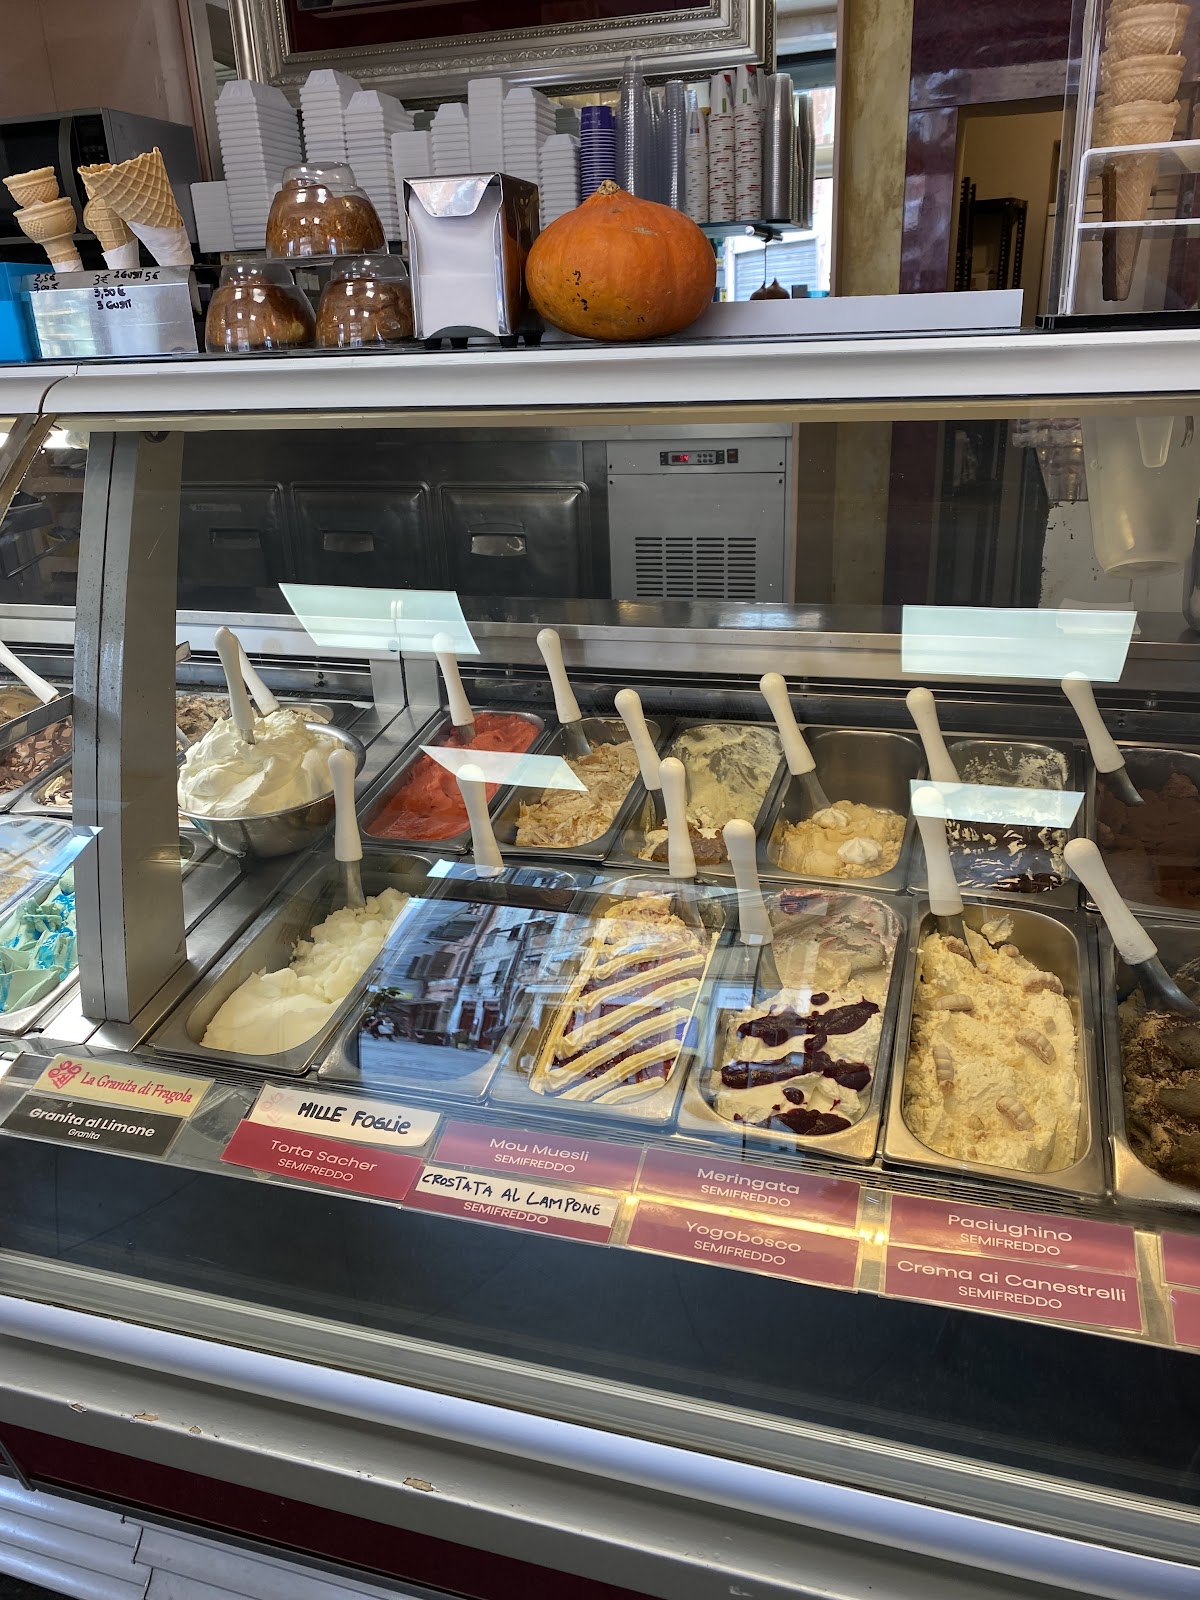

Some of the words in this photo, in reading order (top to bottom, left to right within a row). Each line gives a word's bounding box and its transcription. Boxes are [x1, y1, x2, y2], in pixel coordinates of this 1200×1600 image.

[96, 300, 104, 310] 3
[80, 1072, 95, 1086] La
[97, 1074, 137, 1093] Granita
[138, 1080, 152, 1095] di
[152, 1084, 193, 1105] Fragola
[29, 1107, 82, 1126] Granita
[85, 1116, 100, 1128] al
[99, 1119, 156, 1137] Limone
[297, 1102, 348, 1123] MILLE
[68, 1128, 101, 1140] Granita
[270, 1139, 312, 1159] Torta
[316, 1151, 379, 1172] Sacher
[489, 1138, 528, 1153] Mou
[531, 1144, 590, 1162] Muesli
[277, 1158, 354, 1182] SEMIFREDDO
[494, 1153, 576, 1173] SEMIFREDDO
[697, 1168, 800, 1195] Meringata
[421, 1173, 493, 1197] CROSTATA
[501, 1187, 521, 1202] AL
[526, 1192, 601, 1216] LAMPONE
[700, 1184, 791, 1207] SEMIFREDDO
[463, 1201, 549, 1225] SEMIFREDDO
[686, 1221, 801, 1253] Yogobosco
[948, 1214, 1073, 1242] Paciughino
[693, 1240, 786, 1265] SEMIFREDDO
[960, 1233, 1061, 1256] SEMIFREDDO
[897, 1260, 973, 1281] Crema
[979, 1271, 999, 1284] ai
[1005, 1274, 1127, 1302] Canestrelli
[958, 1285, 1063, 1310] SEMIFREDDO
